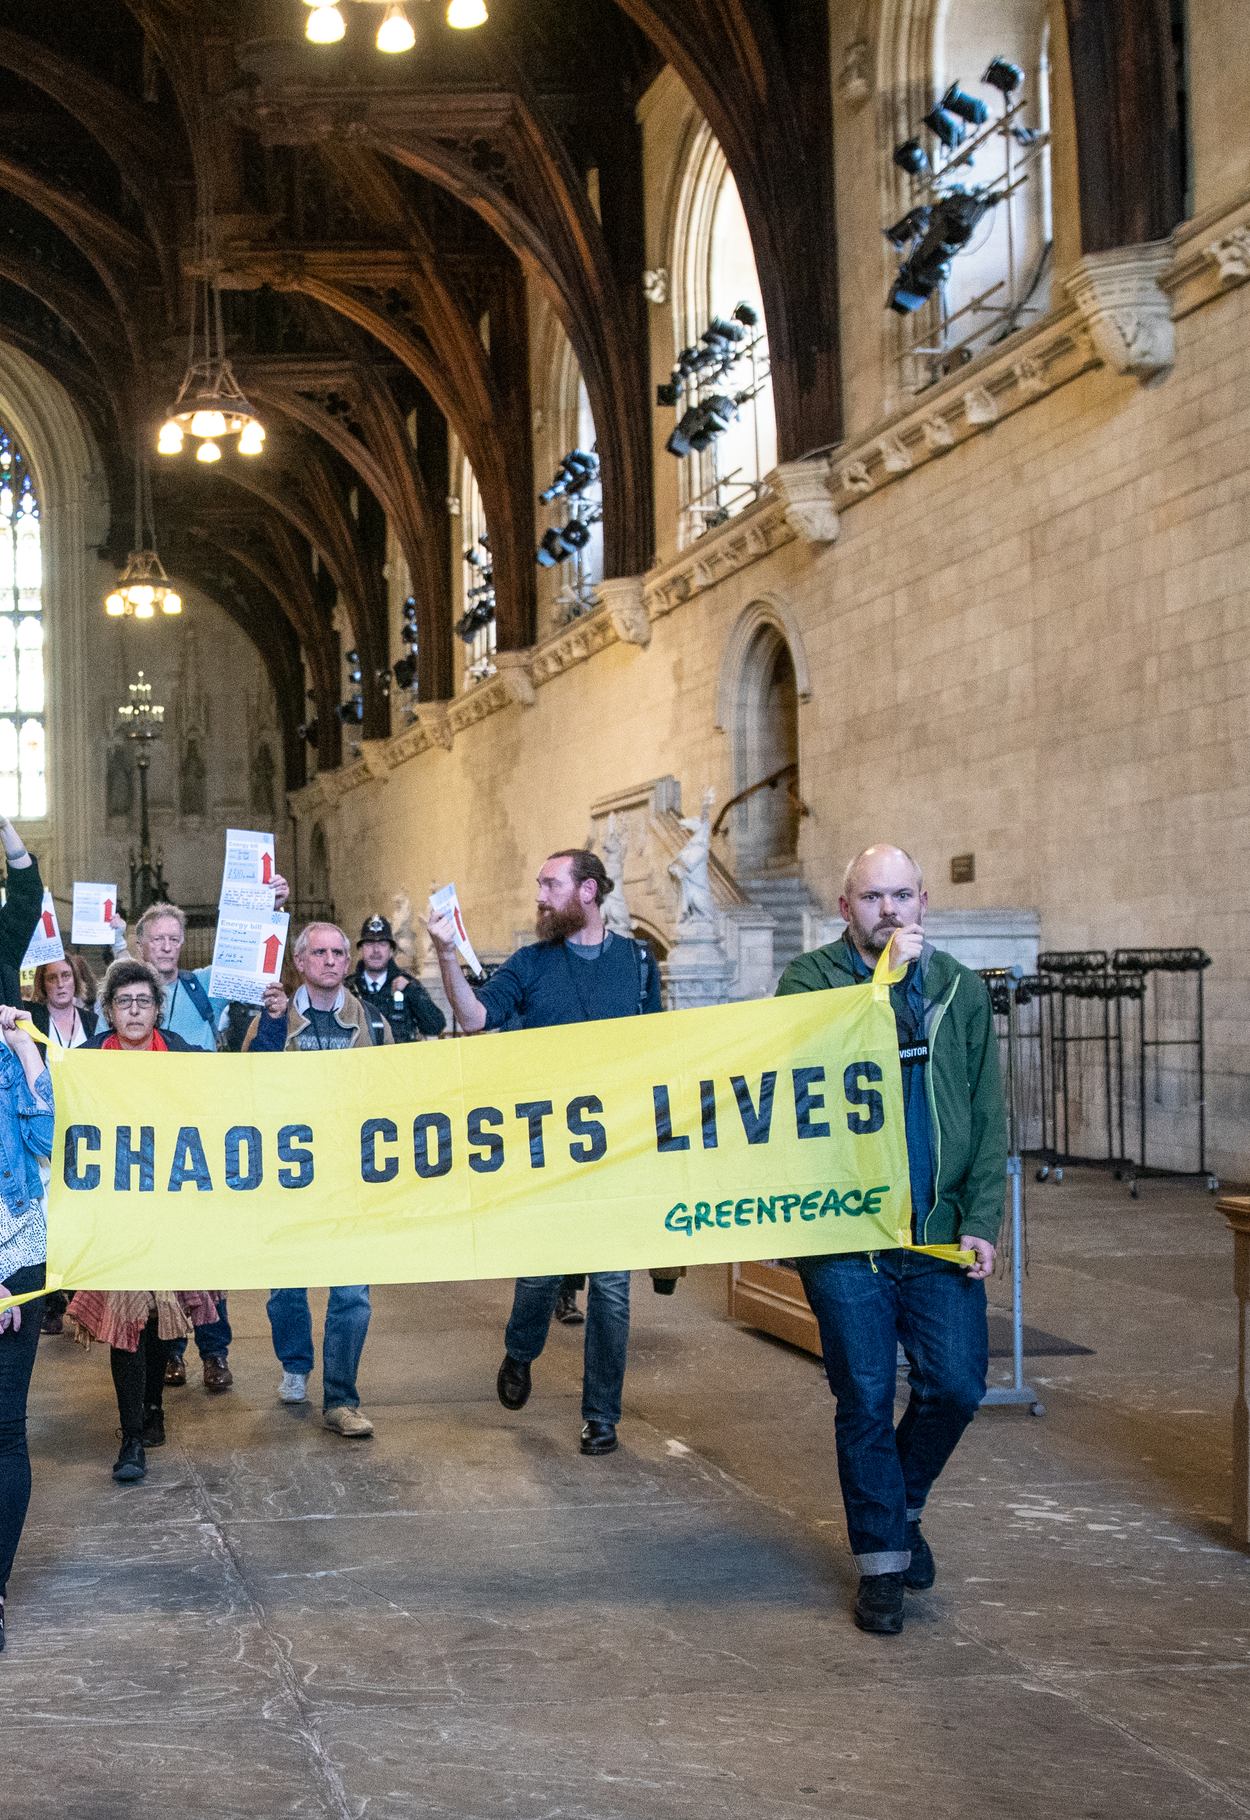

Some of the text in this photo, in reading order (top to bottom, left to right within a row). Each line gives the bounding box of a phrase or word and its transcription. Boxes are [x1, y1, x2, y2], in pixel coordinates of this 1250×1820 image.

[221, 920, 248, 930] Energy
[900, 1046, 928, 1058] VISITOR
[63, 1061, 885, 1192] CHAOS COSTS LIVES
[665, 1186, 890, 1236] GREENPEACE
